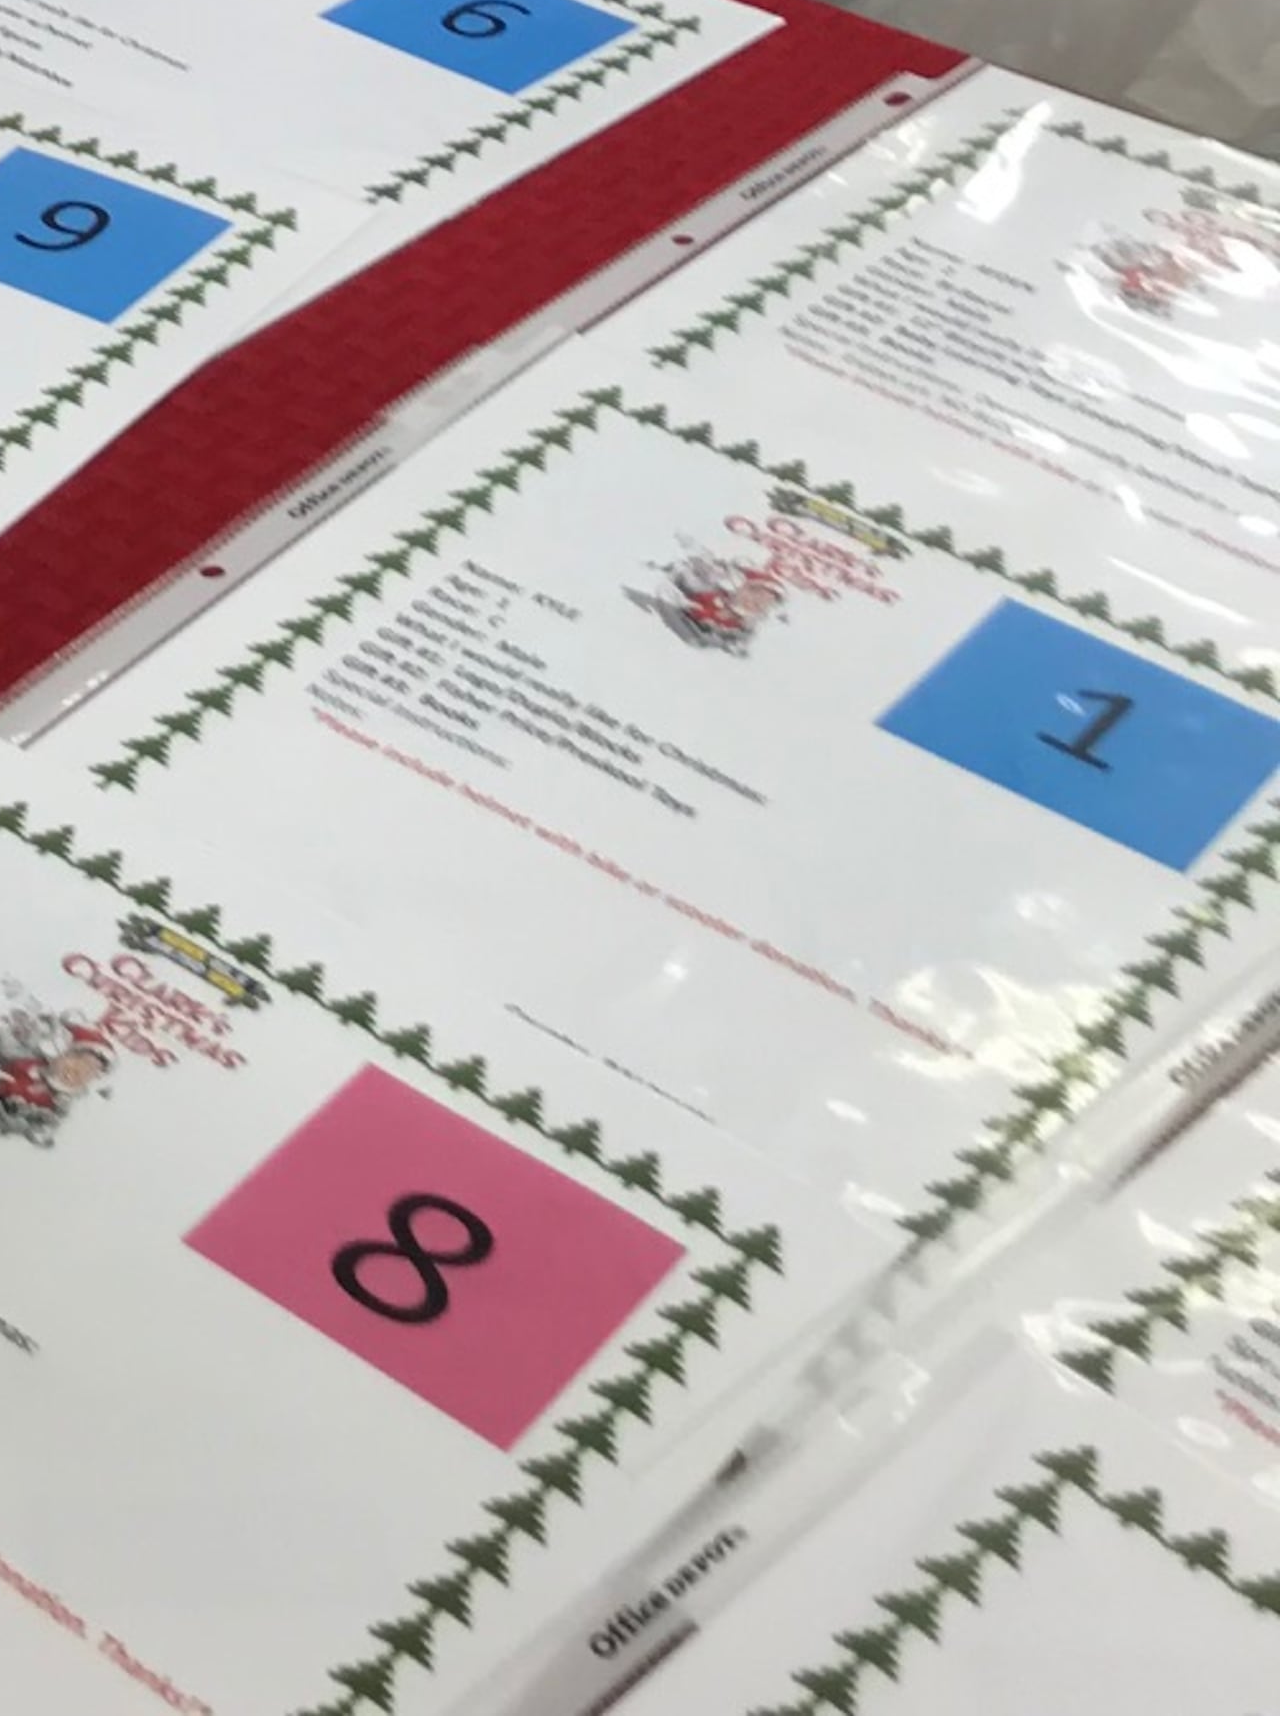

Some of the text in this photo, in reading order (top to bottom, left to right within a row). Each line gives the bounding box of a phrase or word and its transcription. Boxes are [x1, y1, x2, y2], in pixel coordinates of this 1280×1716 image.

[13, 199, 112, 253] 9
[1035, 688, 1136, 774] 1
[330, 1192, 495, 1325] 8
[589, 1587, 668, 1662] Office
